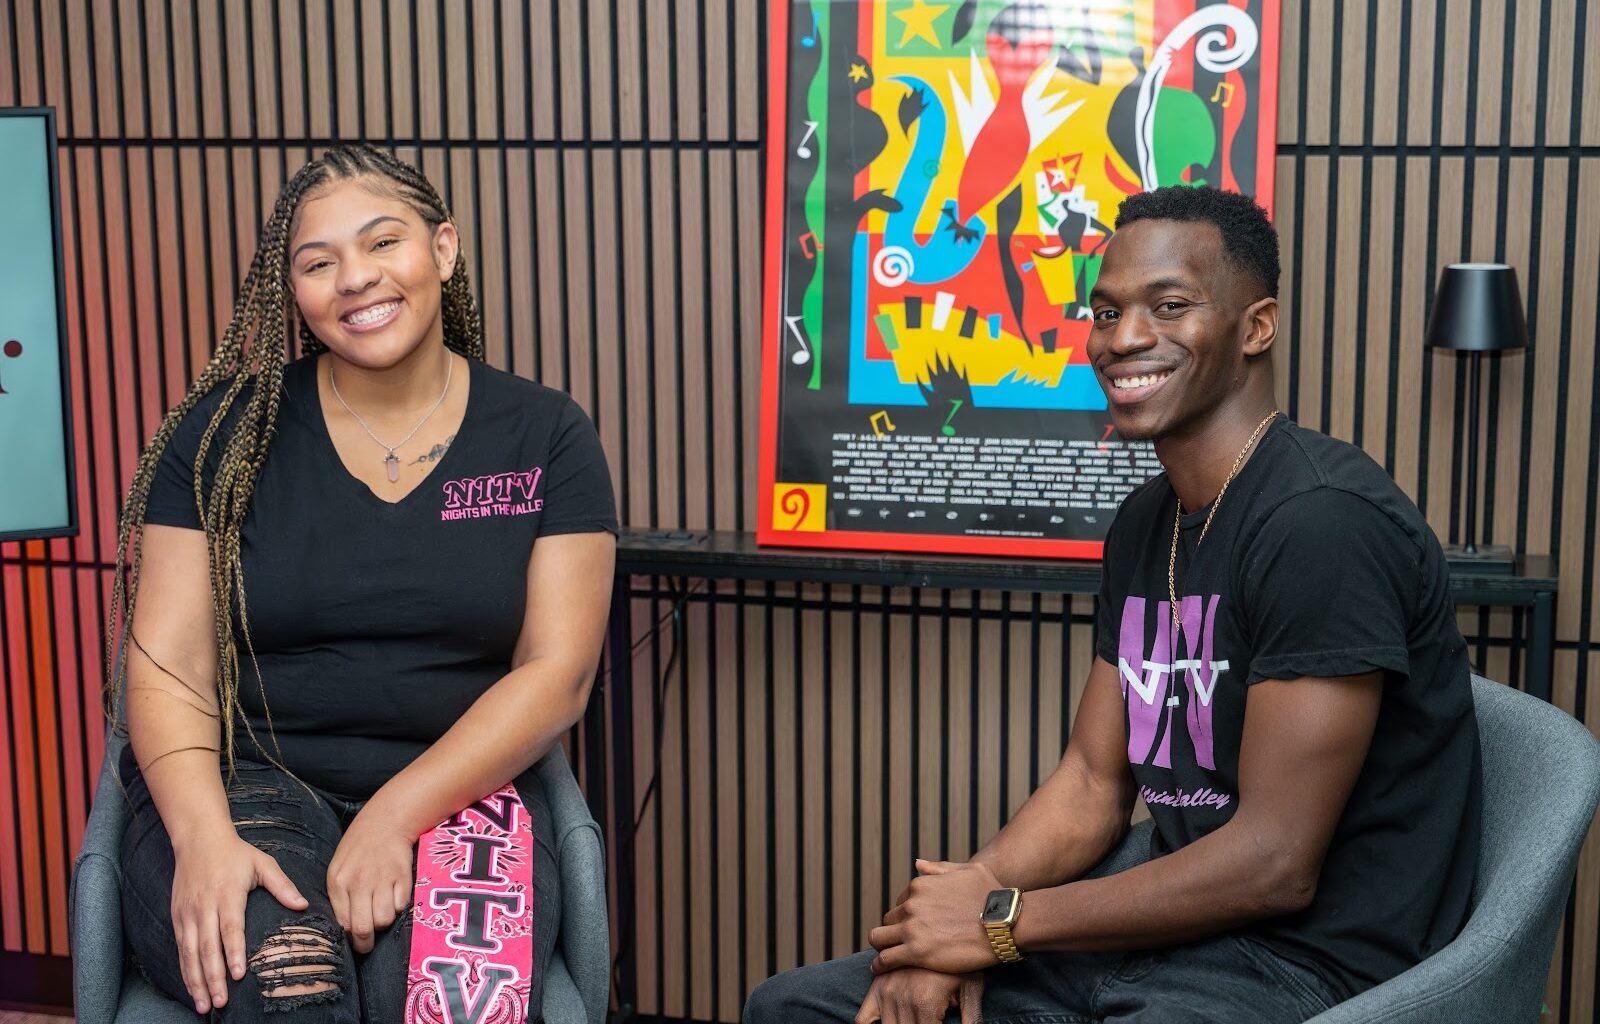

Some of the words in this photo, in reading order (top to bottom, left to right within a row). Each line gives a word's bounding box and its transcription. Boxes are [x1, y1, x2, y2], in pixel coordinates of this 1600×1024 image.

[443, 466, 542, 508] NITV
[441, 507, 480, 521] NIGHTS
[480, 506, 491, 517] IN
[492, 504, 510, 516] THE
[510, 499, 544, 516] VALLE
